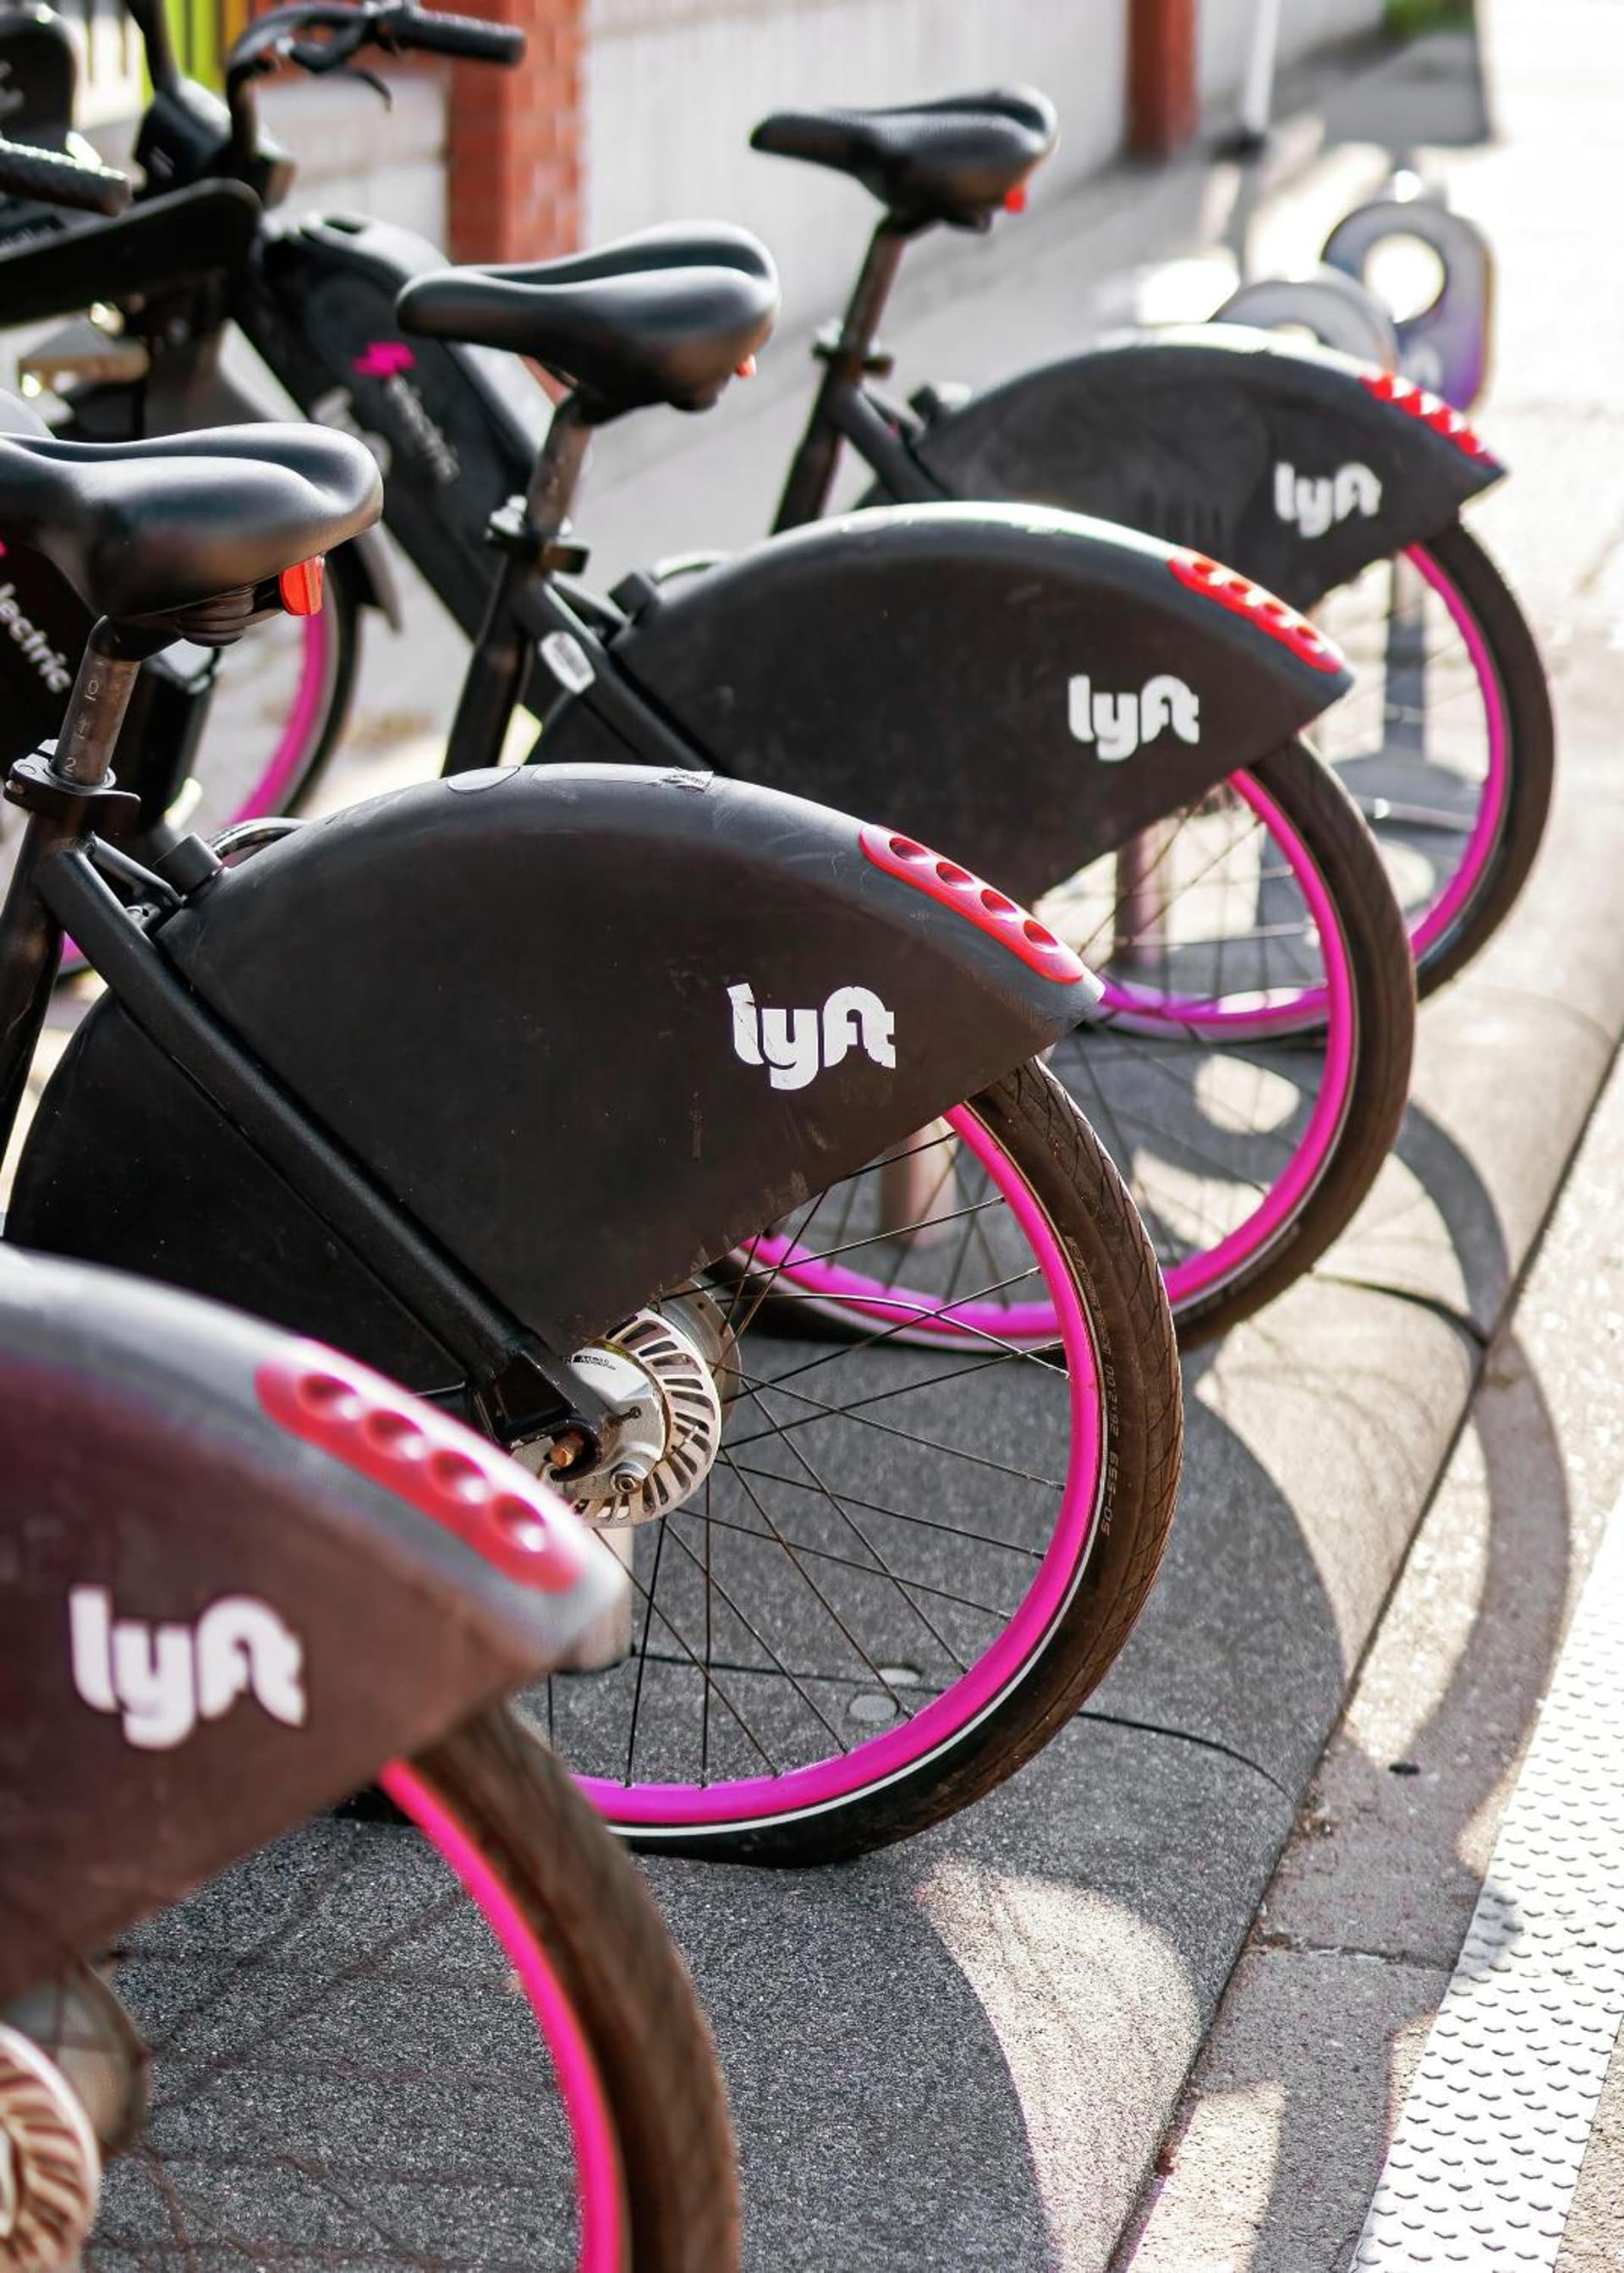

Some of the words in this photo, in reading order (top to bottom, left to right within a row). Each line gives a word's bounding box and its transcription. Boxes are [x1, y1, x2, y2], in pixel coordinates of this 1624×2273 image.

[1275, 463, 1381, 537] lyft
[0, 581, 73, 694] lectric
[1069, 675, 1199, 760] lyft
[727, 983, 896, 1090] lyft
[72, 1590, 304, 1746] lyft
